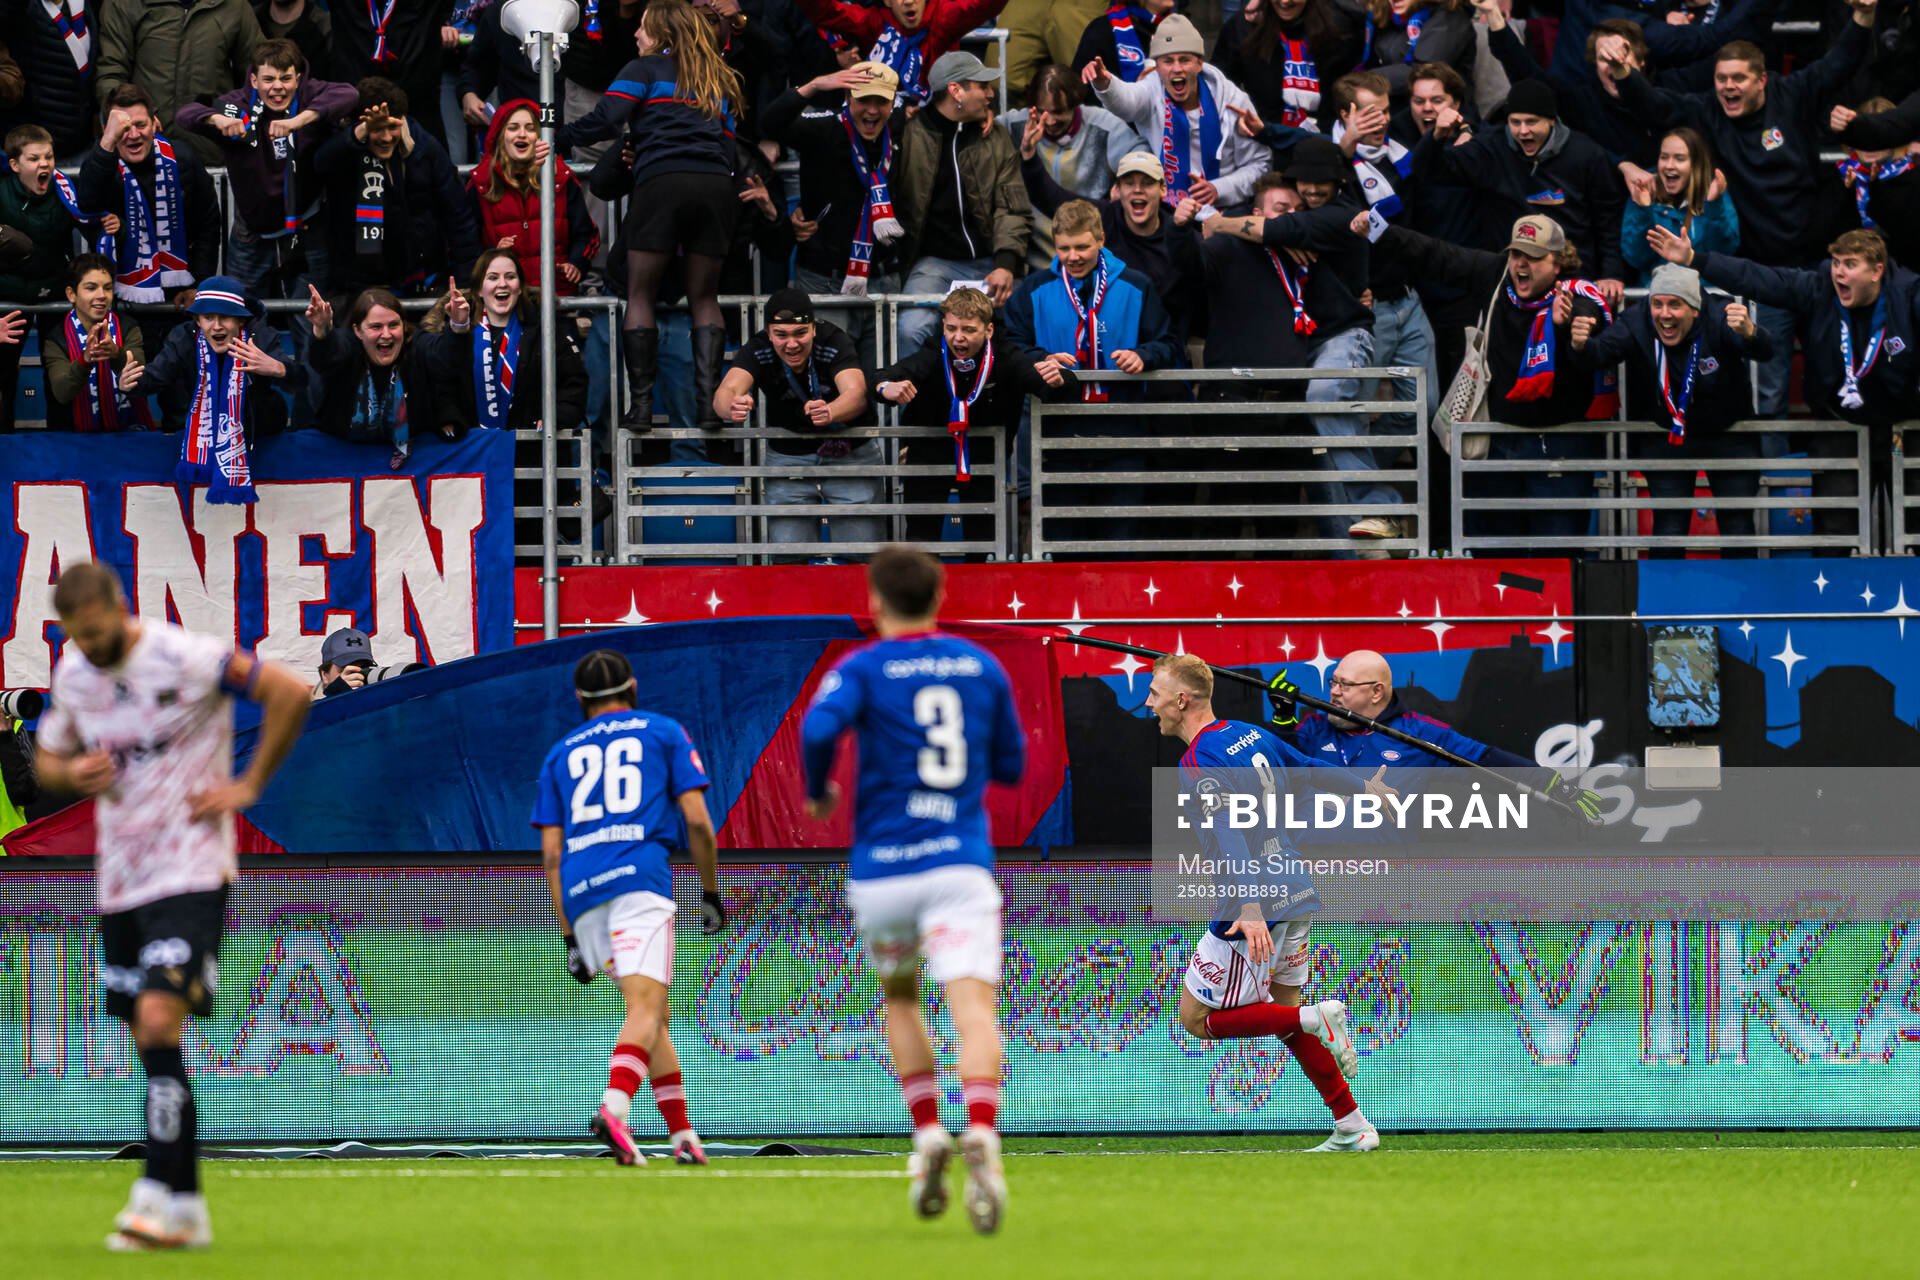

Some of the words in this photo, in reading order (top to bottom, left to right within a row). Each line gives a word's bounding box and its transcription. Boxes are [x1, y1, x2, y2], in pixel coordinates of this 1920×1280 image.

[1, 474, 485, 690] ANEN
[567, 736, 643, 824] 26
[914, 684, 968, 789] 3
[1272, 896, 1289, 911] mot
[1290, 886, 1316, 904] rasisme
